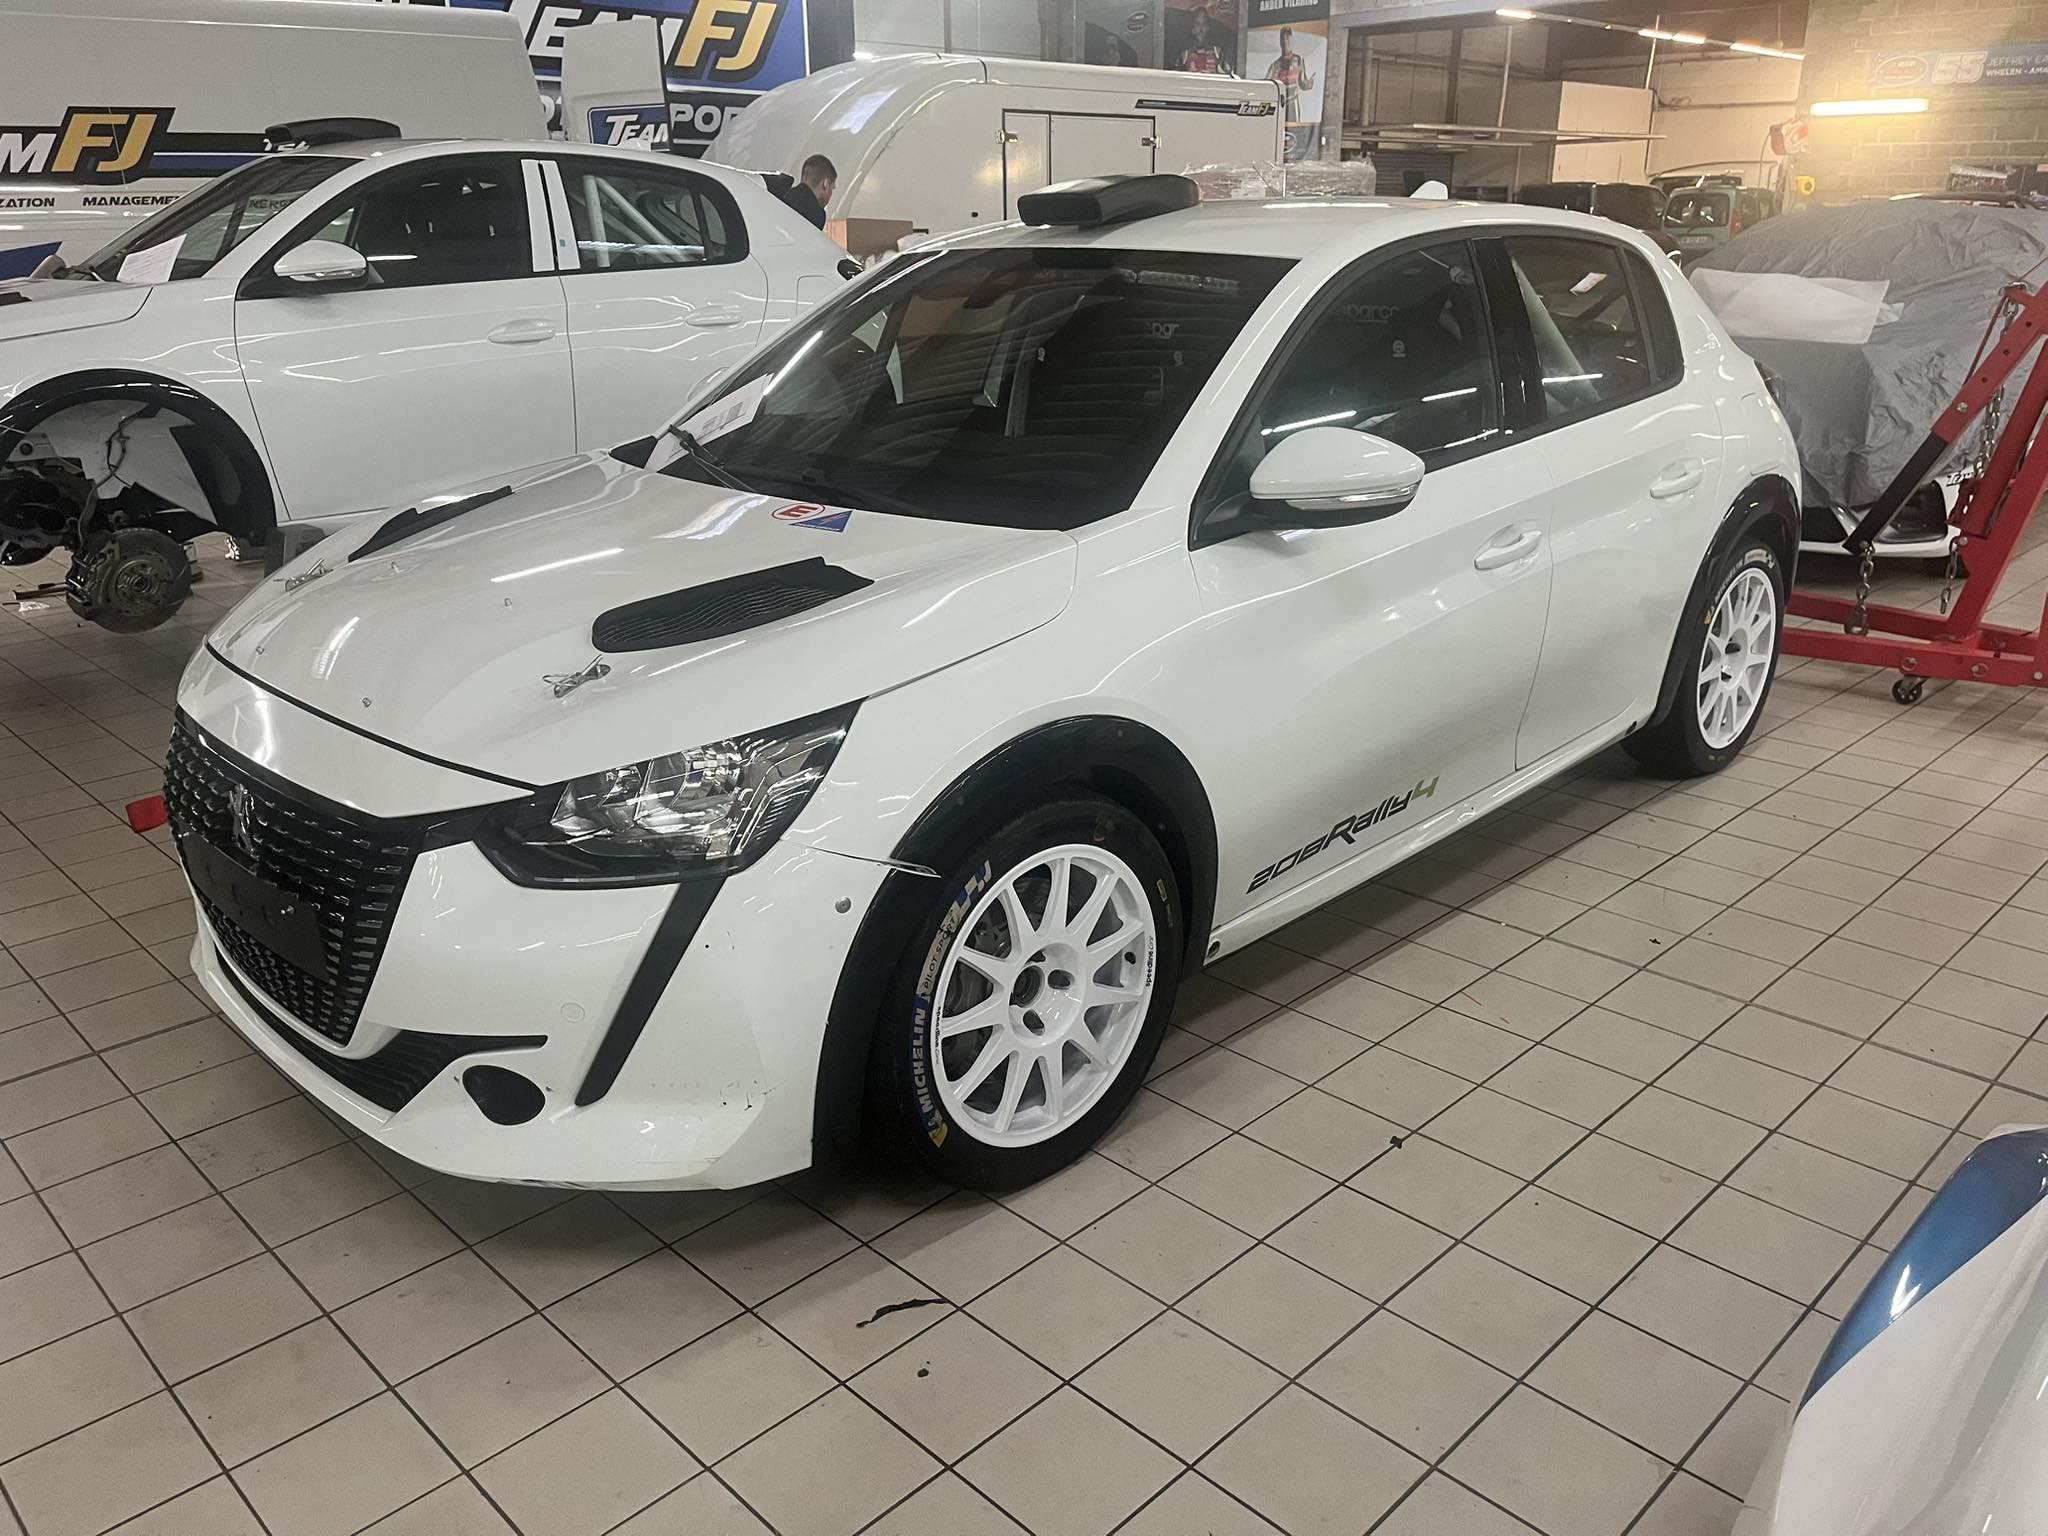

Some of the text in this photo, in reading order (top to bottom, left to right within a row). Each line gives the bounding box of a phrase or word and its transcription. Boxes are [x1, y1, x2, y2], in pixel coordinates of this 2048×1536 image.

[674, 0, 777, 71] FJ
[1932, 51, 1988, 85] 55
[51, 113, 157, 172] FJ
[923, 917, 956, 990] PILOT SPORT
[912, 1007, 934, 1113] MICHELIN
